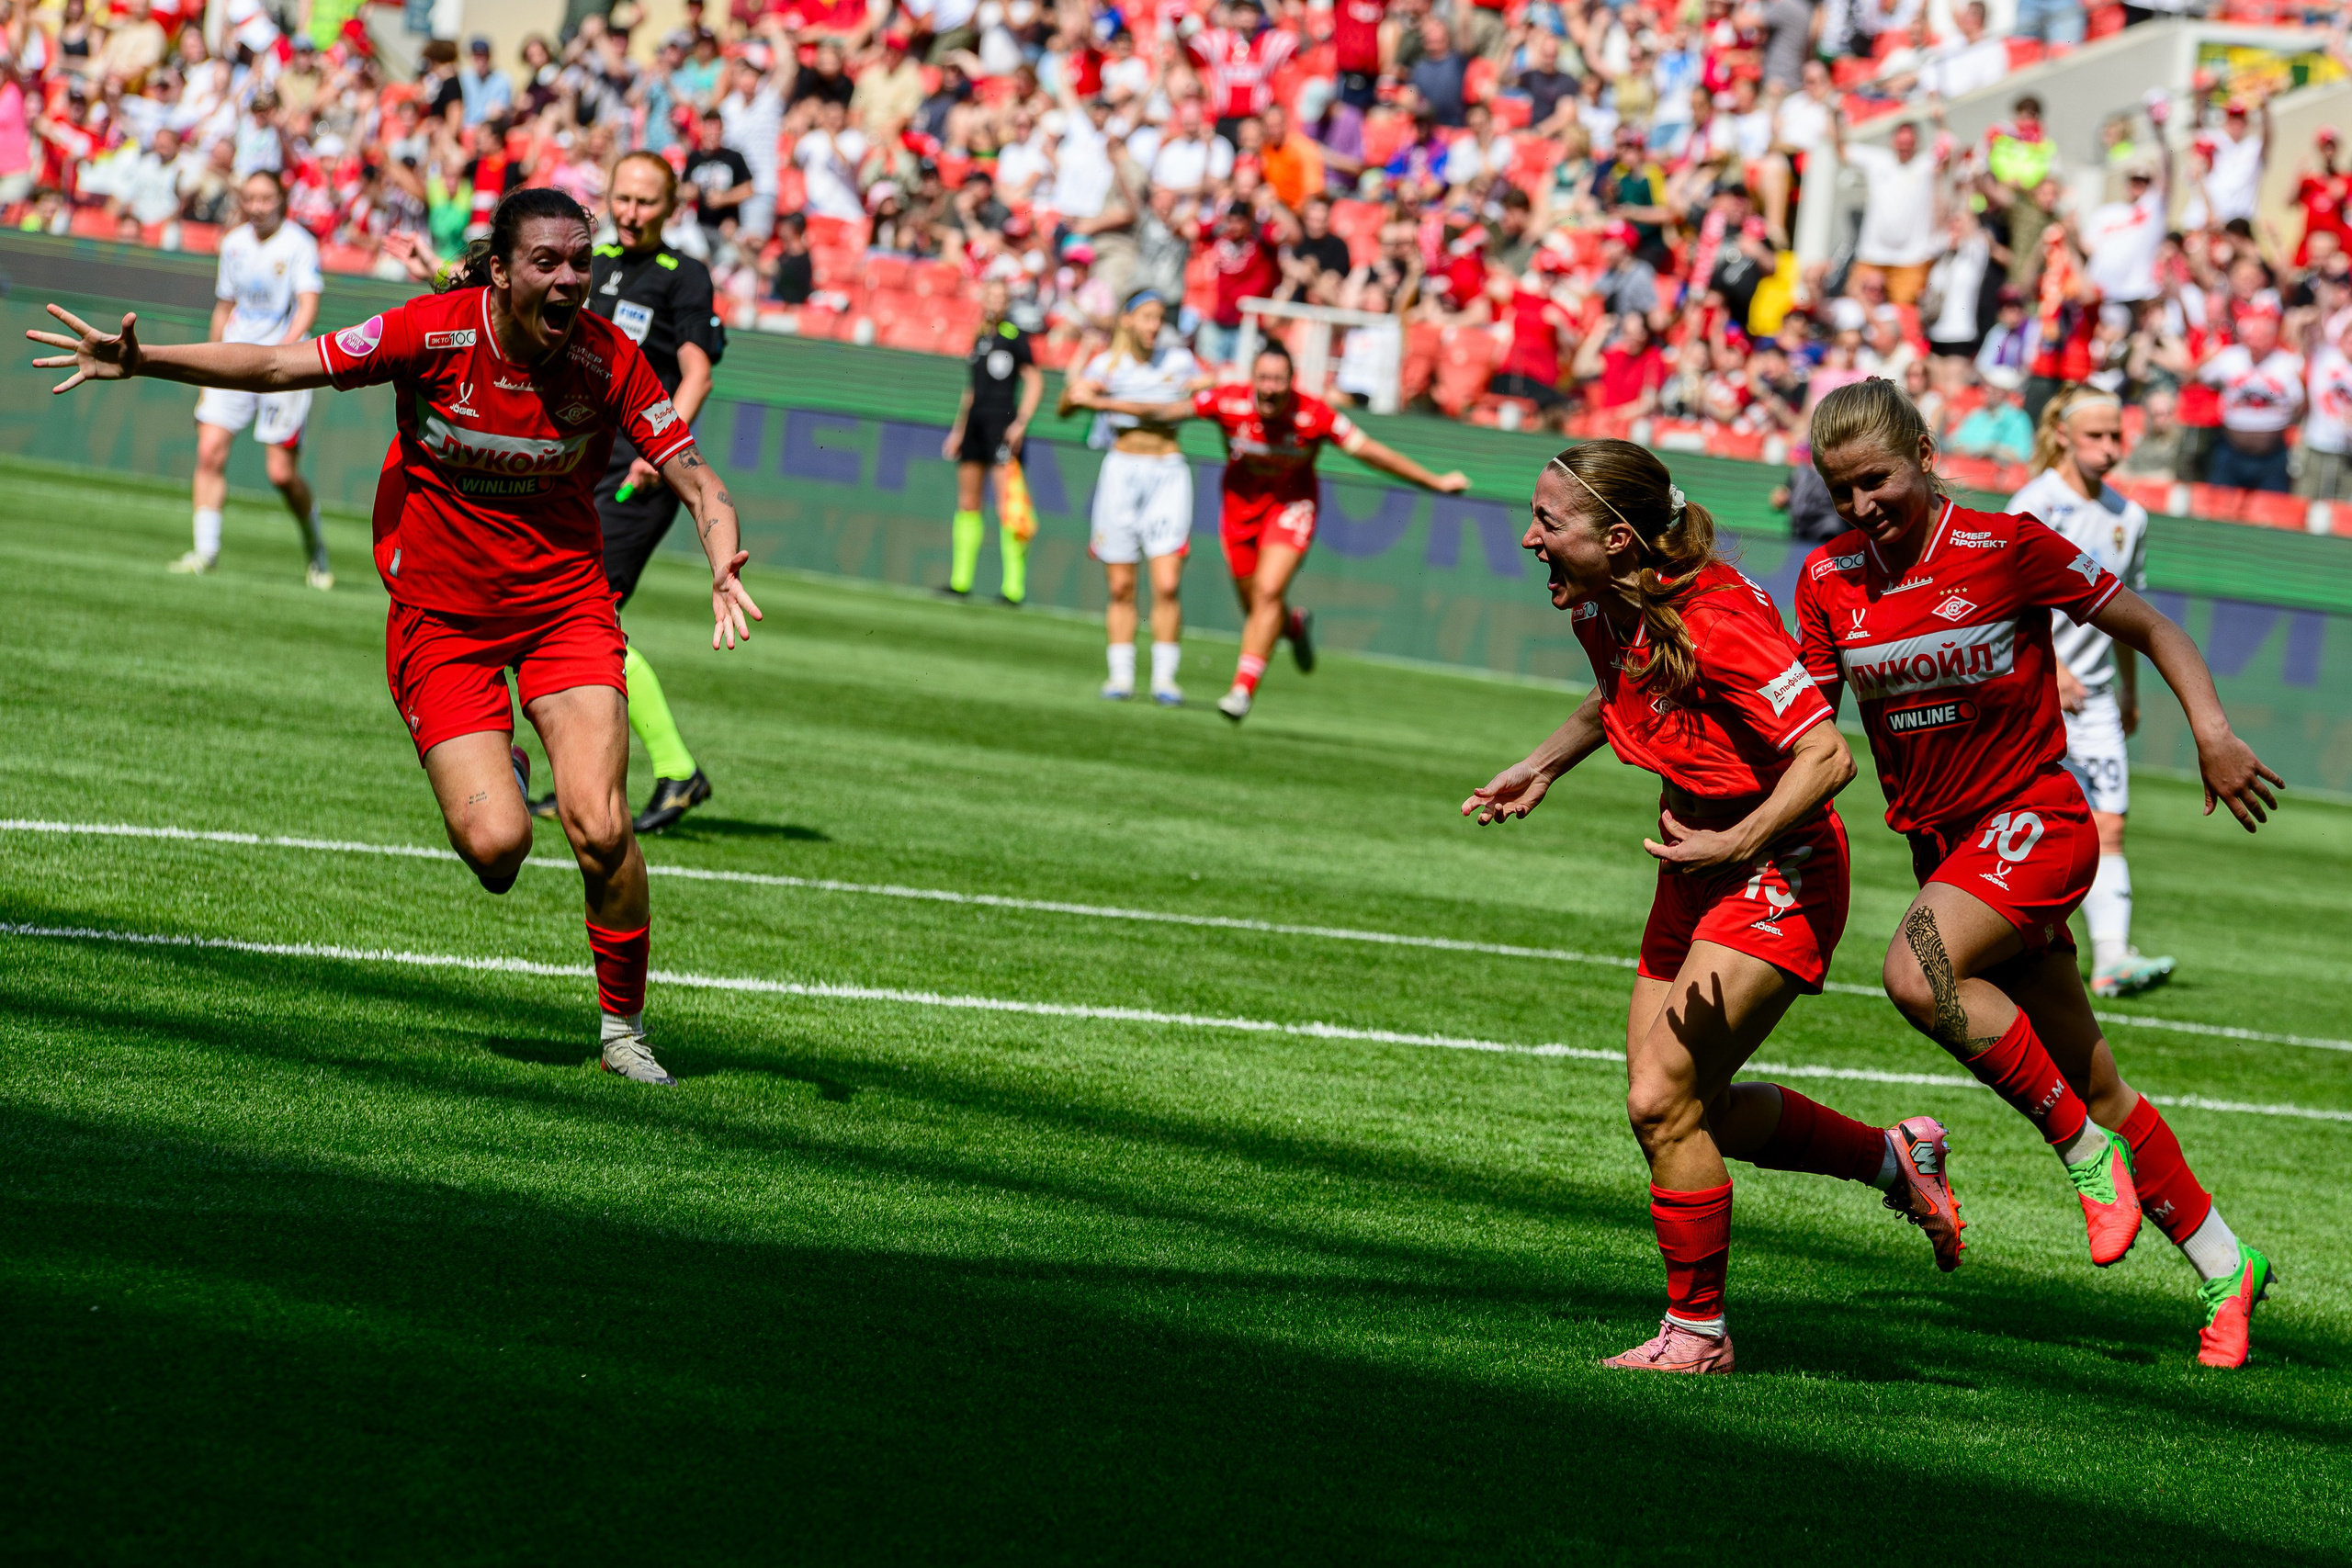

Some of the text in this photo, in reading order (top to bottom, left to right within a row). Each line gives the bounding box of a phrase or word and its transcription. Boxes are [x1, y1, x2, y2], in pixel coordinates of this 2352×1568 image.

[437, 434, 579, 474] ЛУКОЙЛ
[461, 477, 537, 494] WINLINE
[1949, 536, 2007, 548] ПРОТЕКТ
[1951, 528, 1992, 540] КИБЕР
[1845, 630, 1871, 641] JÖGEL
[1849, 641, 1995, 693] ЛУКОЙЛ
[1889, 705, 1957, 730] WINLINE
[1978, 811, 2045, 862] 10
[1744, 845, 1813, 908] 13
[1979, 873, 2010, 892] JÖGEL
[1750, 921, 1784, 937] JÖGEL
